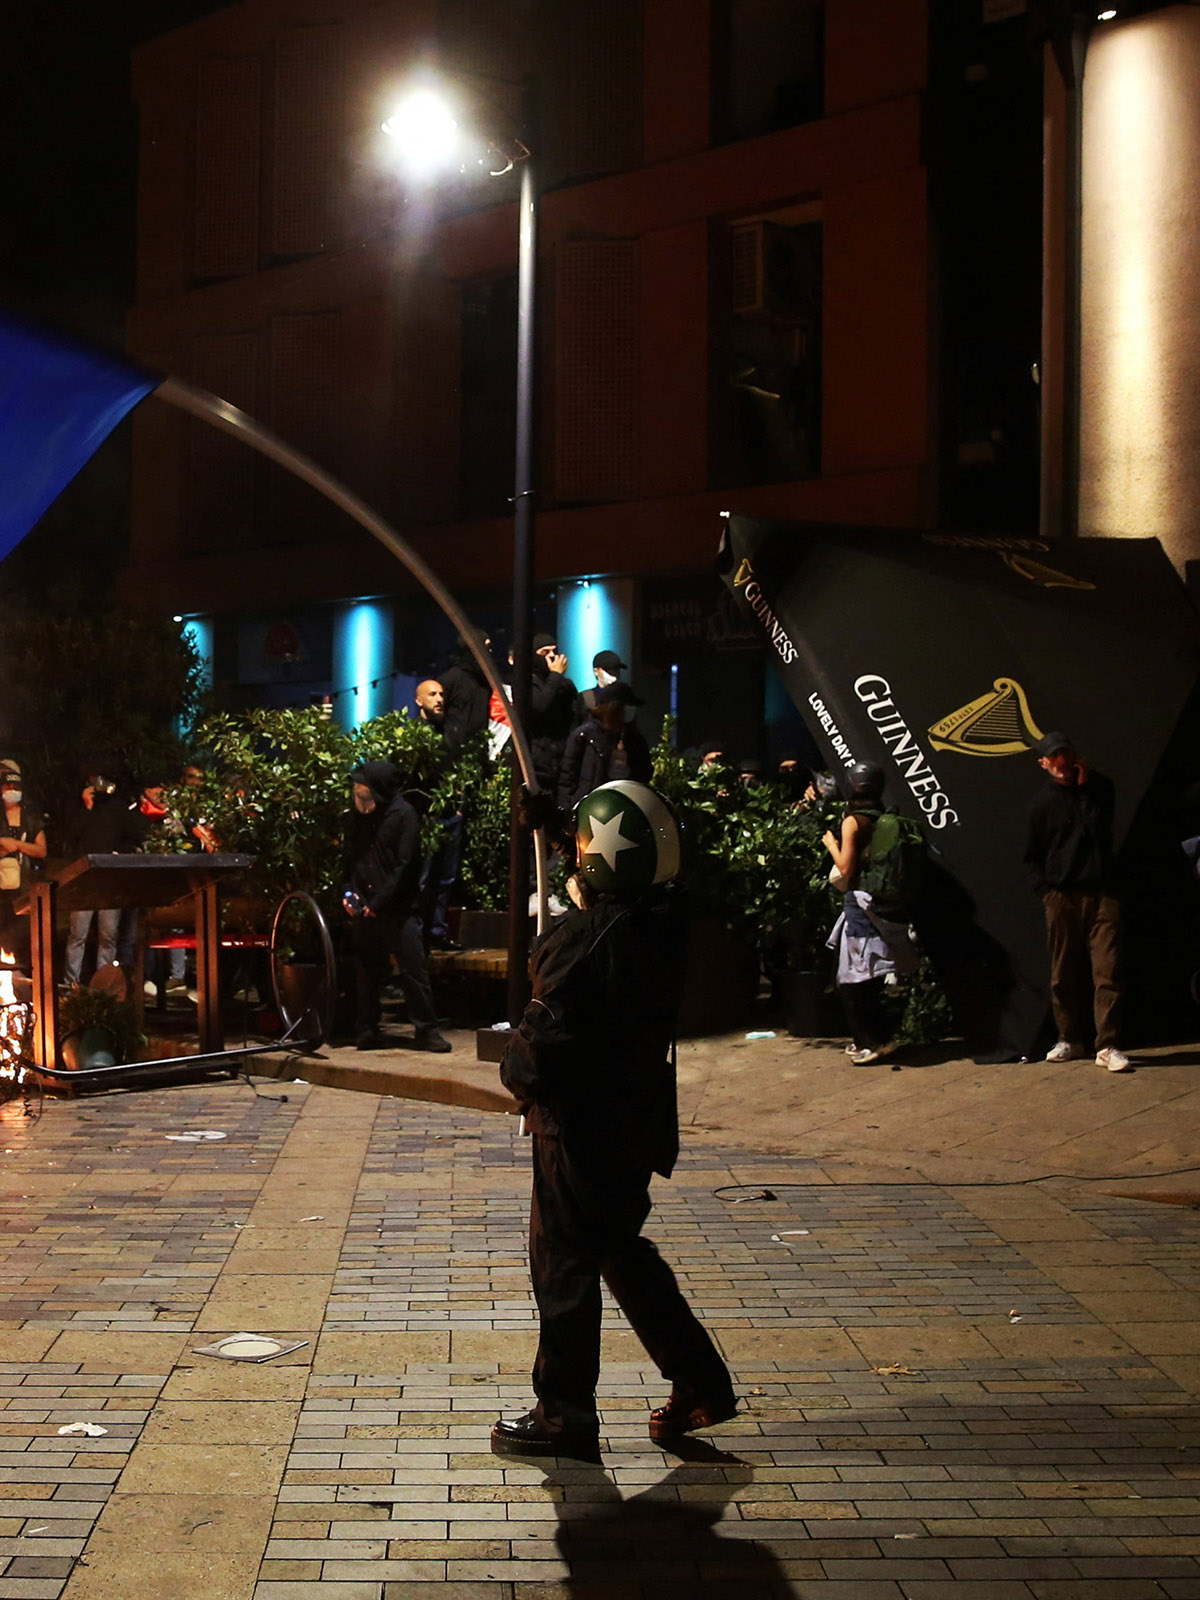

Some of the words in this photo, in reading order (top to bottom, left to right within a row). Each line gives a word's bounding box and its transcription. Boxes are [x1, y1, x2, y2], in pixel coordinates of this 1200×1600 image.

[744, 581, 799, 664] GUINNESS
[808, 691, 840, 737] LOVELY
[831, 734, 853, 760] DAY
[853, 673, 959, 830] GUINNESS
